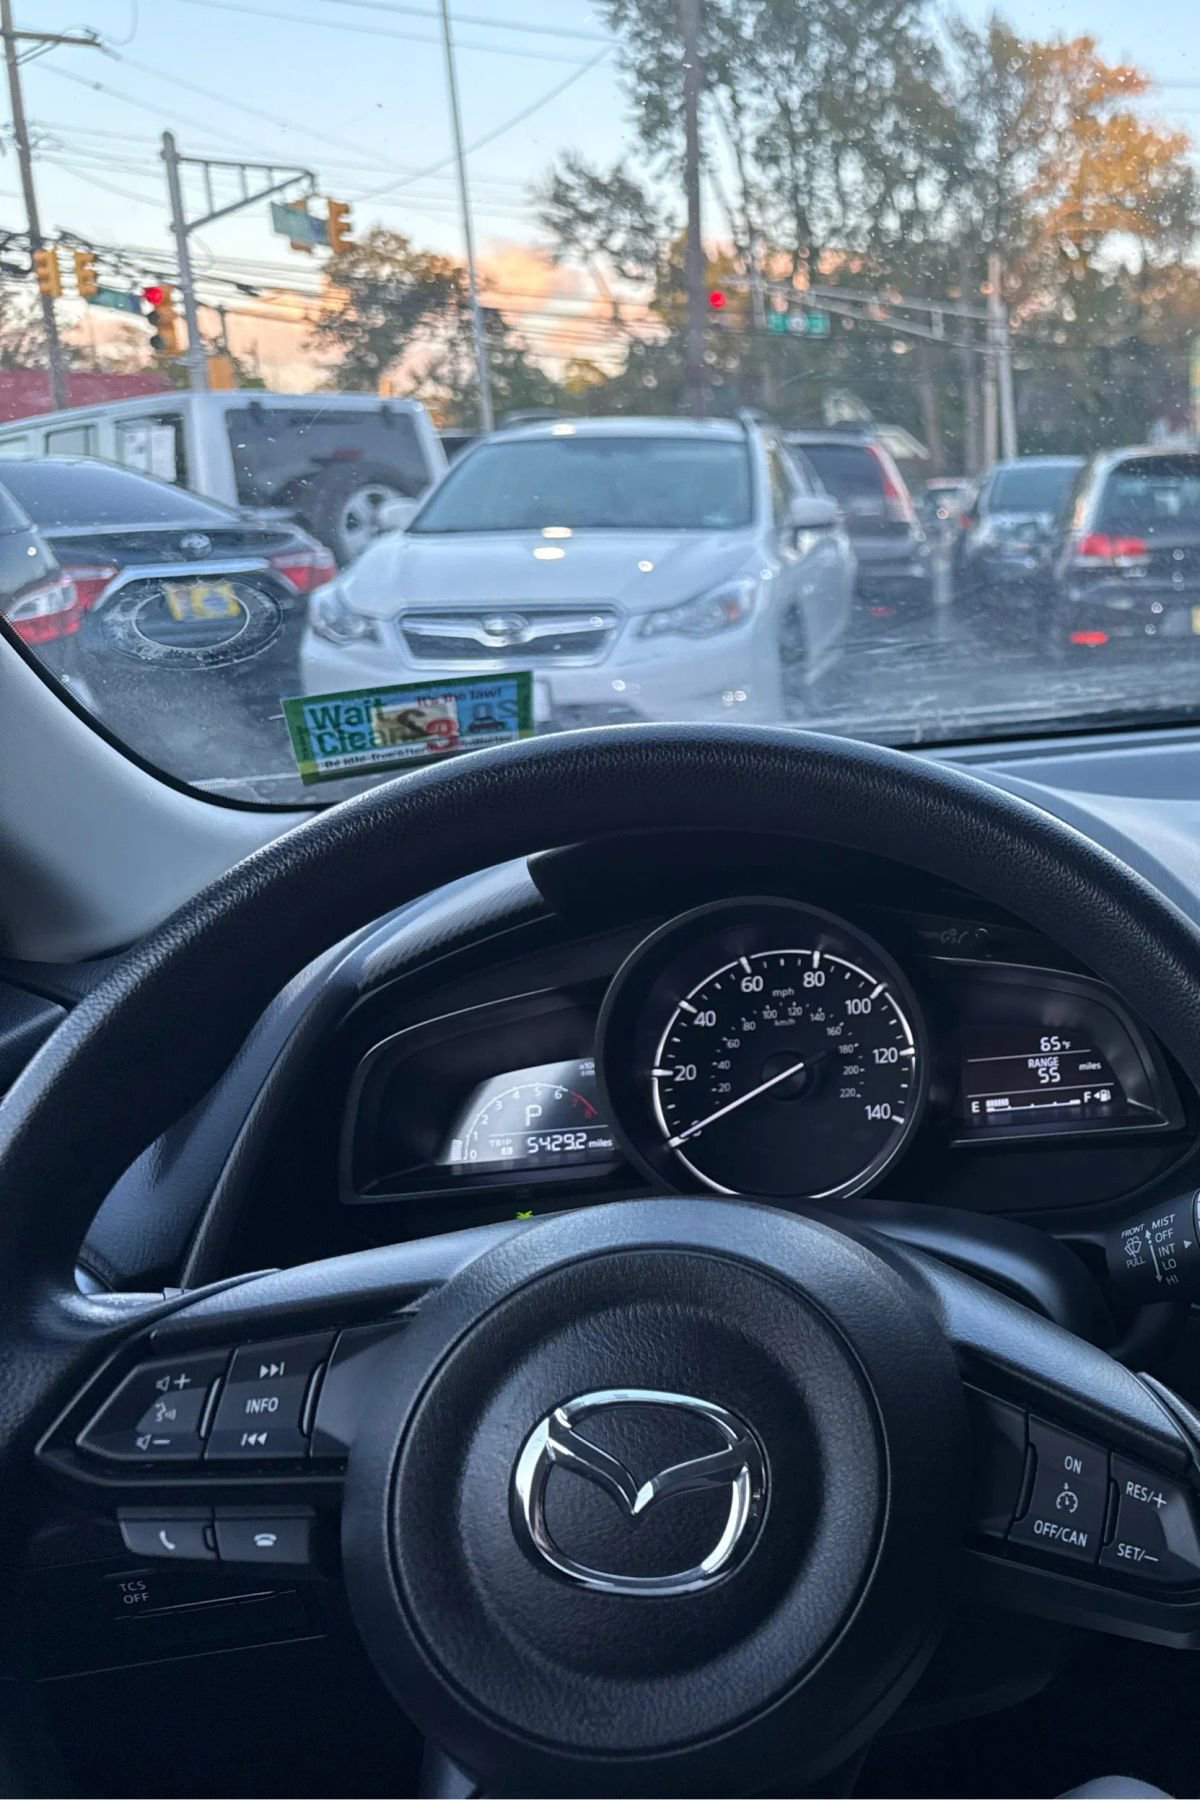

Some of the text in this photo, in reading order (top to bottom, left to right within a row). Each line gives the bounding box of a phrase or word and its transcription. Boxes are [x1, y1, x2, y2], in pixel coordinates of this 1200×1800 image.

[308, 698, 386, 731] Wait
[740, 976, 764, 993] 60
[803, 971, 826, 988] 80
[772, 987, 795, 998] mph
[787, 1007, 803, 1017] 120
[844, 998, 873, 1015] 100
[693, 1011, 717, 1027] 40
[762, 1009, 778, 1019] 100
[810, 1012, 826, 1022] 140
[742, 1021, 757, 1032] 80
[826, 1025, 843, 1036] 160
[726, 1037, 741, 1049] 60
[838, 1043, 855, 1054] 180
[1040, 1036, 1061, 1051] 65
[872, 1047, 899, 1065] 120
[718, 1059, 732, 1070] 40
[1028, 1057, 1060, 1069] RANGE
[674, 1065, 698, 1082] 20
[843, 1065, 859, 1075] 200
[1038, 1061, 1102, 1083] 55 miles
[718, 1082, 732, 1093] 20
[840, 1088, 855, 1098] 220
[512, 1090, 520, 1099] 4
[554, 1090, 563, 1100] 6
[1083, 1091, 1092, 1103] F
[495, 1100, 503, 1110] 3
[971, 1101, 981, 1113] E
[525, 1104, 543, 1127] P
[865, 1104, 892, 1121] 140
[481, 1114, 489, 1125] 2
[588, 1138, 613, 1149] miles
[470, 1149, 478, 1160] 0
[1151, 1213, 1176, 1229] MIST
[1121, 1223, 1145, 1238] FRONT
[1154, 1228, 1174, 1243] OFF
[1158, 1243, 1176, 1257] INT
[1126, 1256, 1146, 1269] PULL
[1161, 1258, 1177, 1271] LO
[1165, 1274, 1180, 1286] HI
[246, 1396, 279, 1413] INFO
[1064, 1456, 1082, 1474] ON
[1033, 1519, 1088, 1548] OFF/CAN
[120, 1580, 147, 1592] TCS
[123, 1593, 149, 1605] OFF
